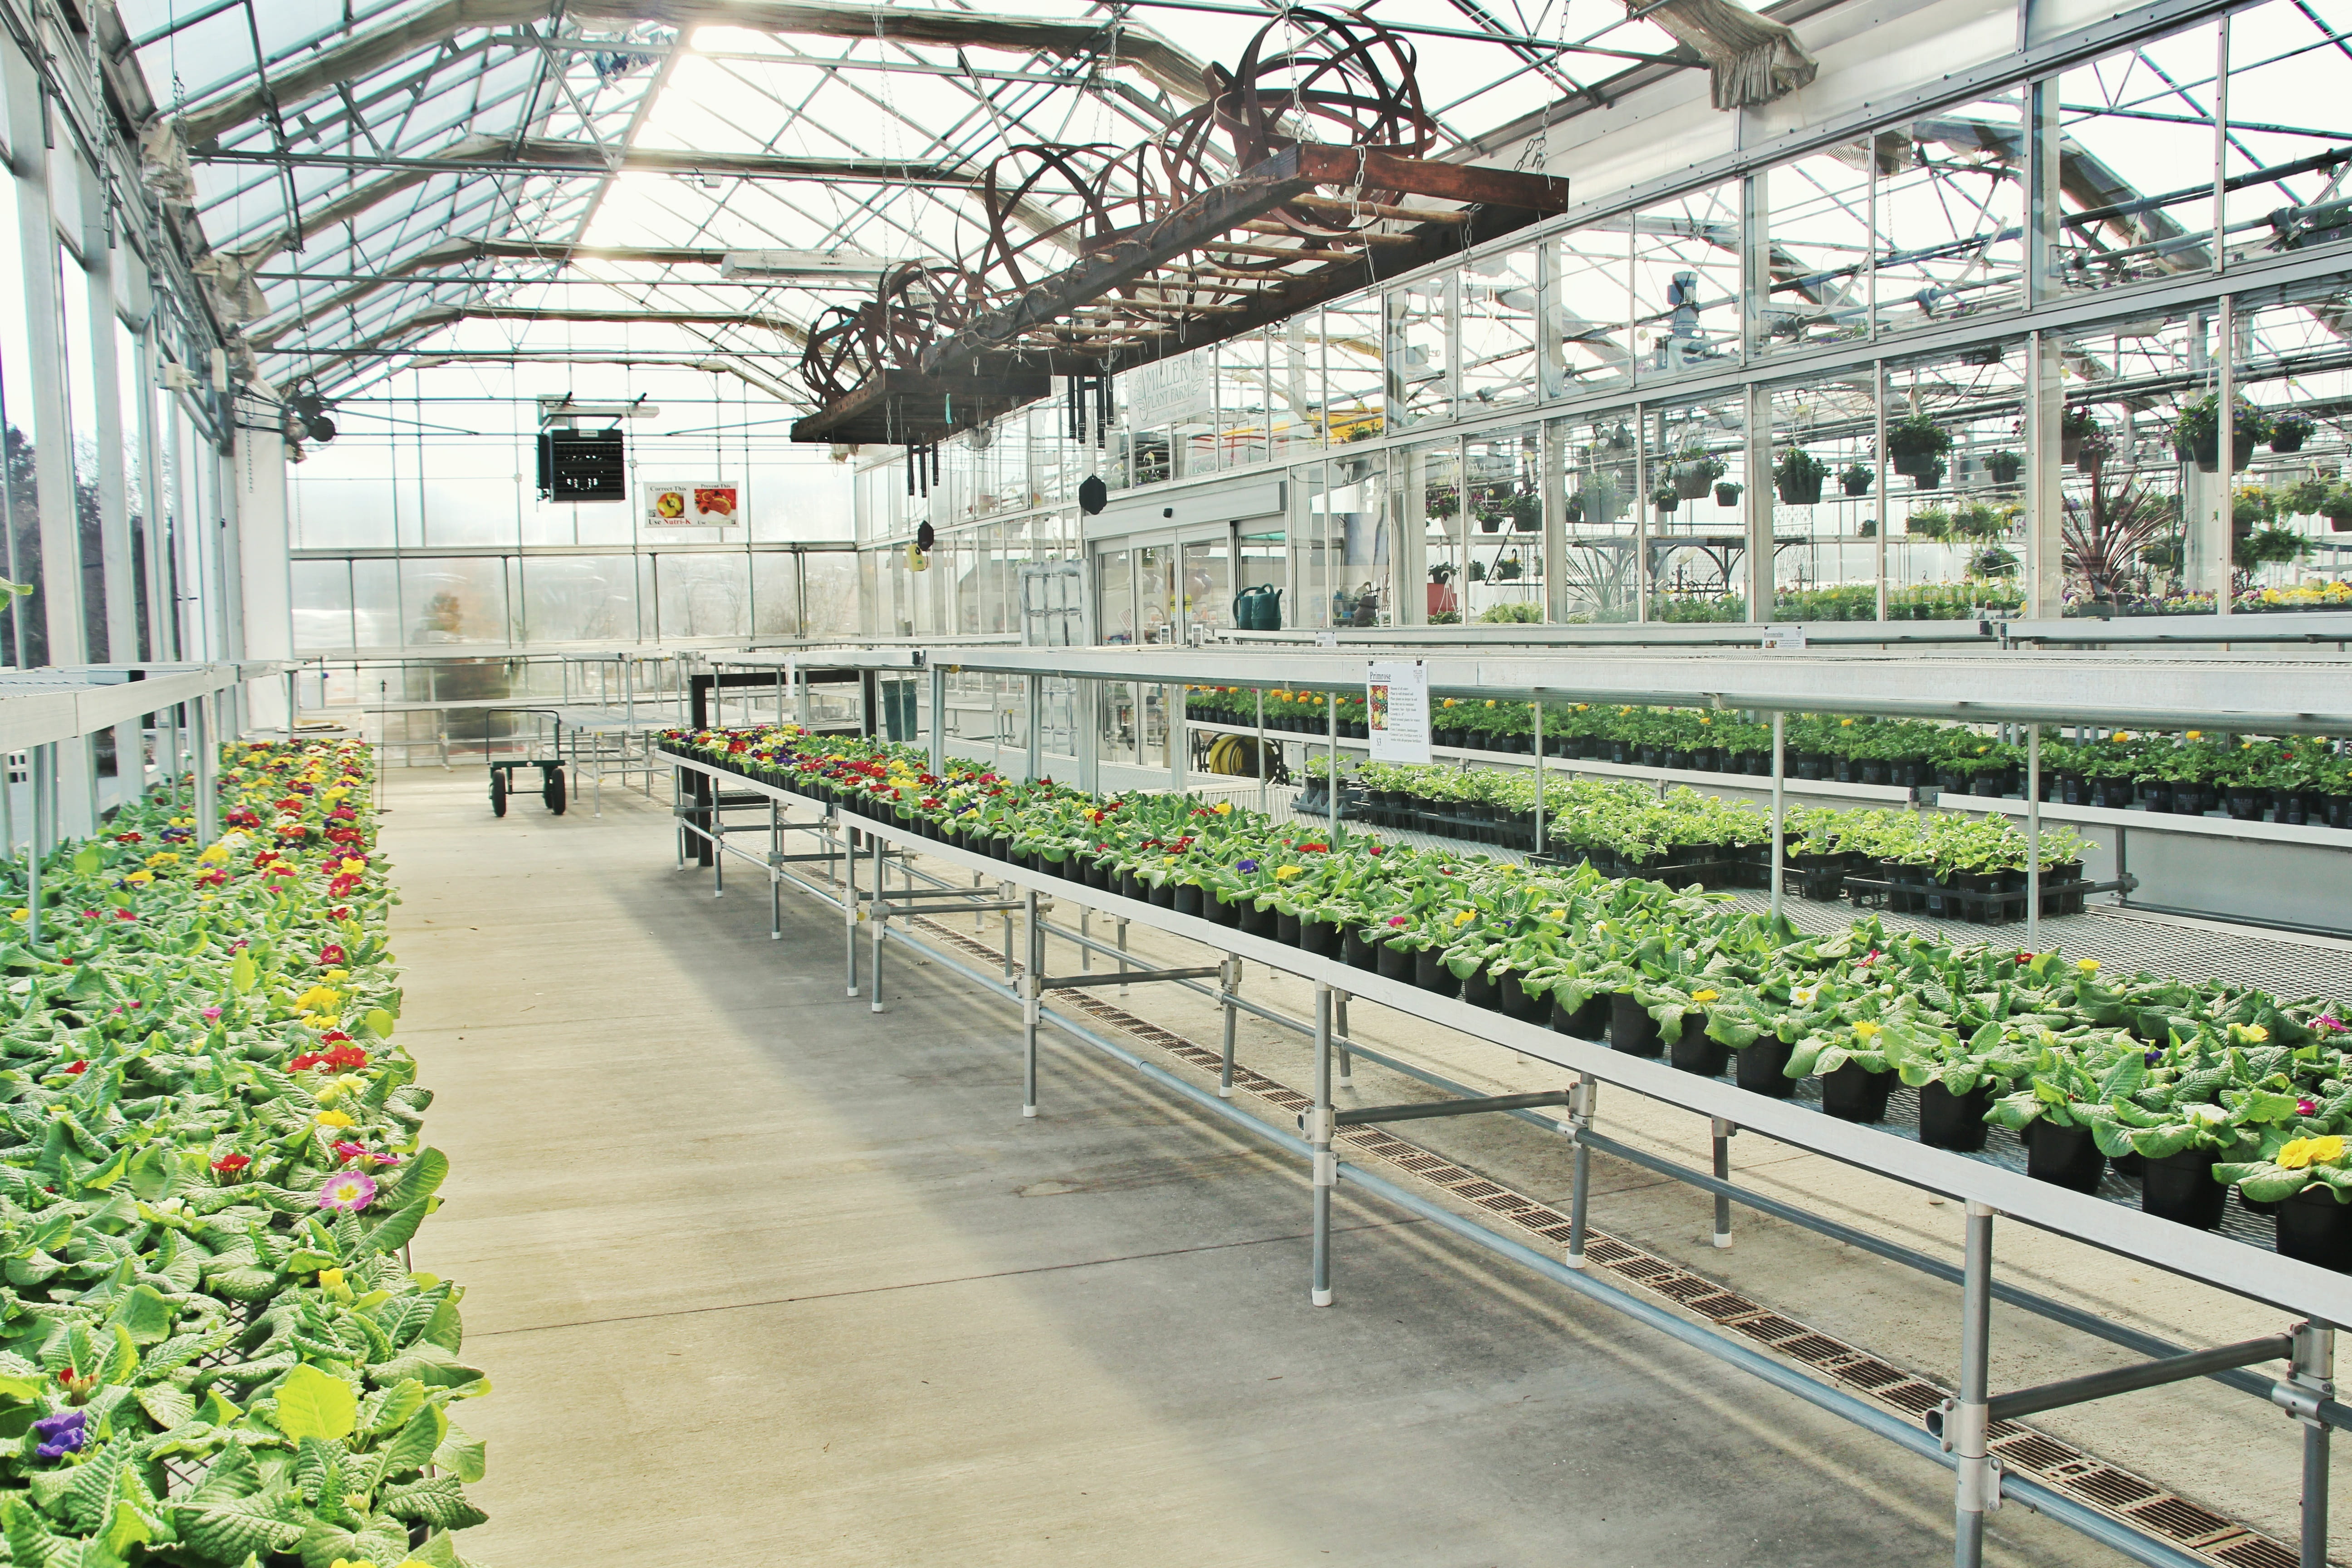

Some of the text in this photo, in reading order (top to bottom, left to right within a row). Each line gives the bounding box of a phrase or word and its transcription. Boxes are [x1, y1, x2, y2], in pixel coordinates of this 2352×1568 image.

[1147, 358, 1188, 392] MILLER
[1147, 384, 1190, 410] PLANT FARM
[1370, 671, 1391, 680] Primrose
[1617, 863, 1641, 871] MILLER
